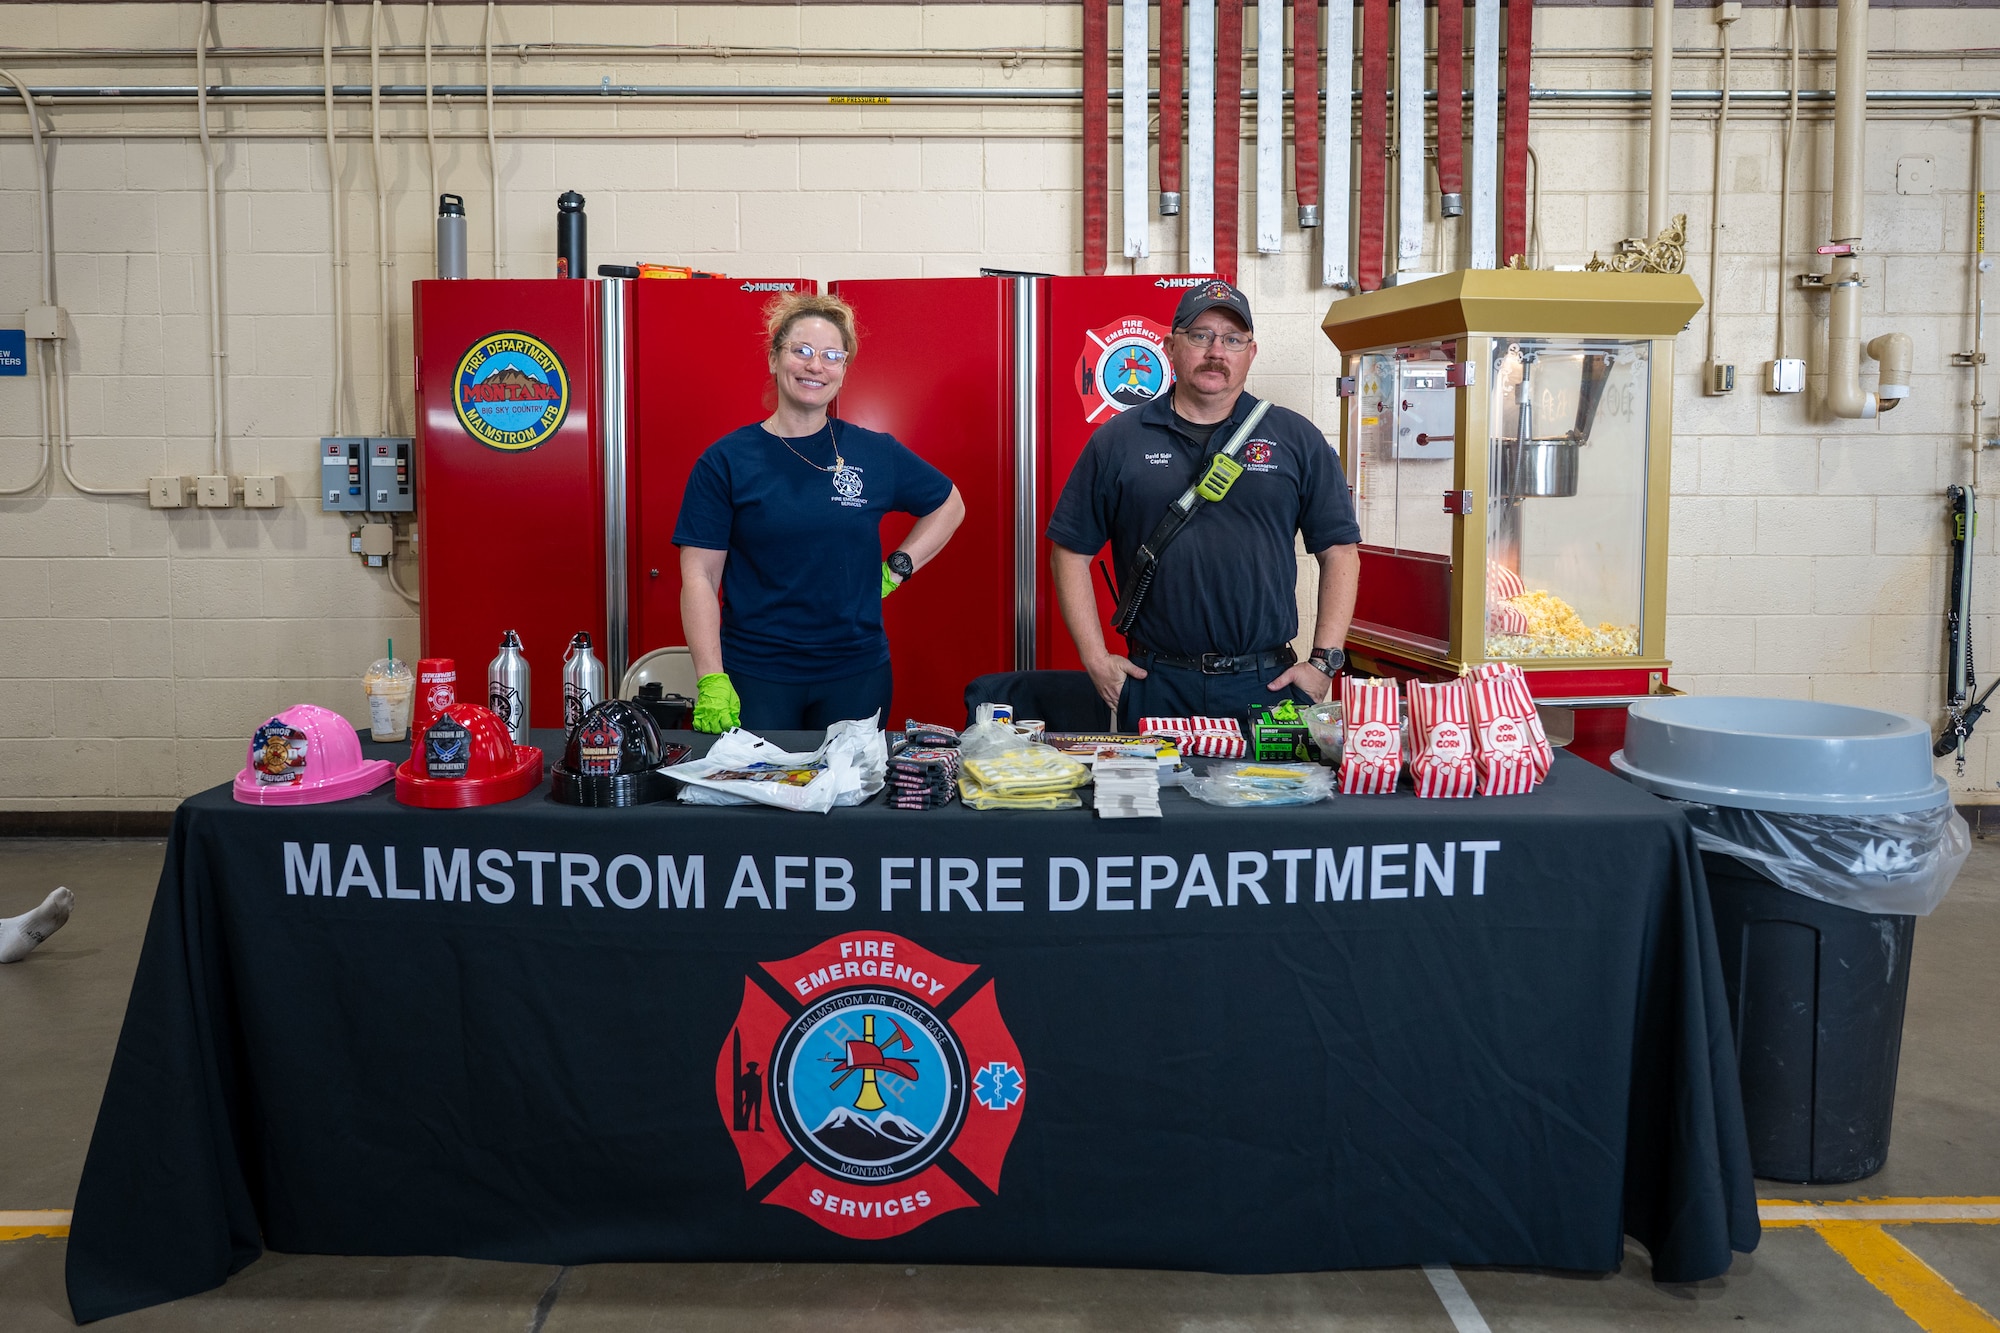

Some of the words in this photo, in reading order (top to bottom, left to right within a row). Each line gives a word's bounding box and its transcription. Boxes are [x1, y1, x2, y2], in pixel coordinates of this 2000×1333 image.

[754, 283, 795, 292] HUSKY
[1122, 320, 1143, 328] FIRE
[1104, 328, 1161, 344] EMERGENCY
[465, 351, 486, 375] FIRE
[487, 340, 556, 373] DEPARTMENT
[462, 382, 560, 403] MONTANA
[512, 405, 543, 414] COUNTRY
[466, 408, 537, 443] MALMSTROM
[540, 405, 559, 428] AFB
[265, 728, 291, 736] JUNIOR
[1365, 730, 1385, 738] POP
[1439, 729, 1457, 739] POP
[1497, 724, 1513, 732] POP
[1360, 740, 1387, 748] CORN
[1435, 740, 1460, 748] CORN
[260, 772, 296, 782] FIREFIGHTER
[283, 841, 705, 909] MALMSTROM
[724, 855, 856, 911] AFB
[880, 857, 1024, 912] FIRE
[1049, 840, 1501, 911] DEPARTMENT
[840, 940, 895, 959] FIRE
[794, 961, 945, 996] EMERGENCY
[797, 995, 864, 1035] MALMSTROM
[868, 994, 887, 1006] AIR
[892, 998, 925, 1022] FORCE
[926, 1020, 949, 1046] BASE
[840, 1163, 894, 1177] MONTANA
[809, 1188, 931, 1218] SERVICES
